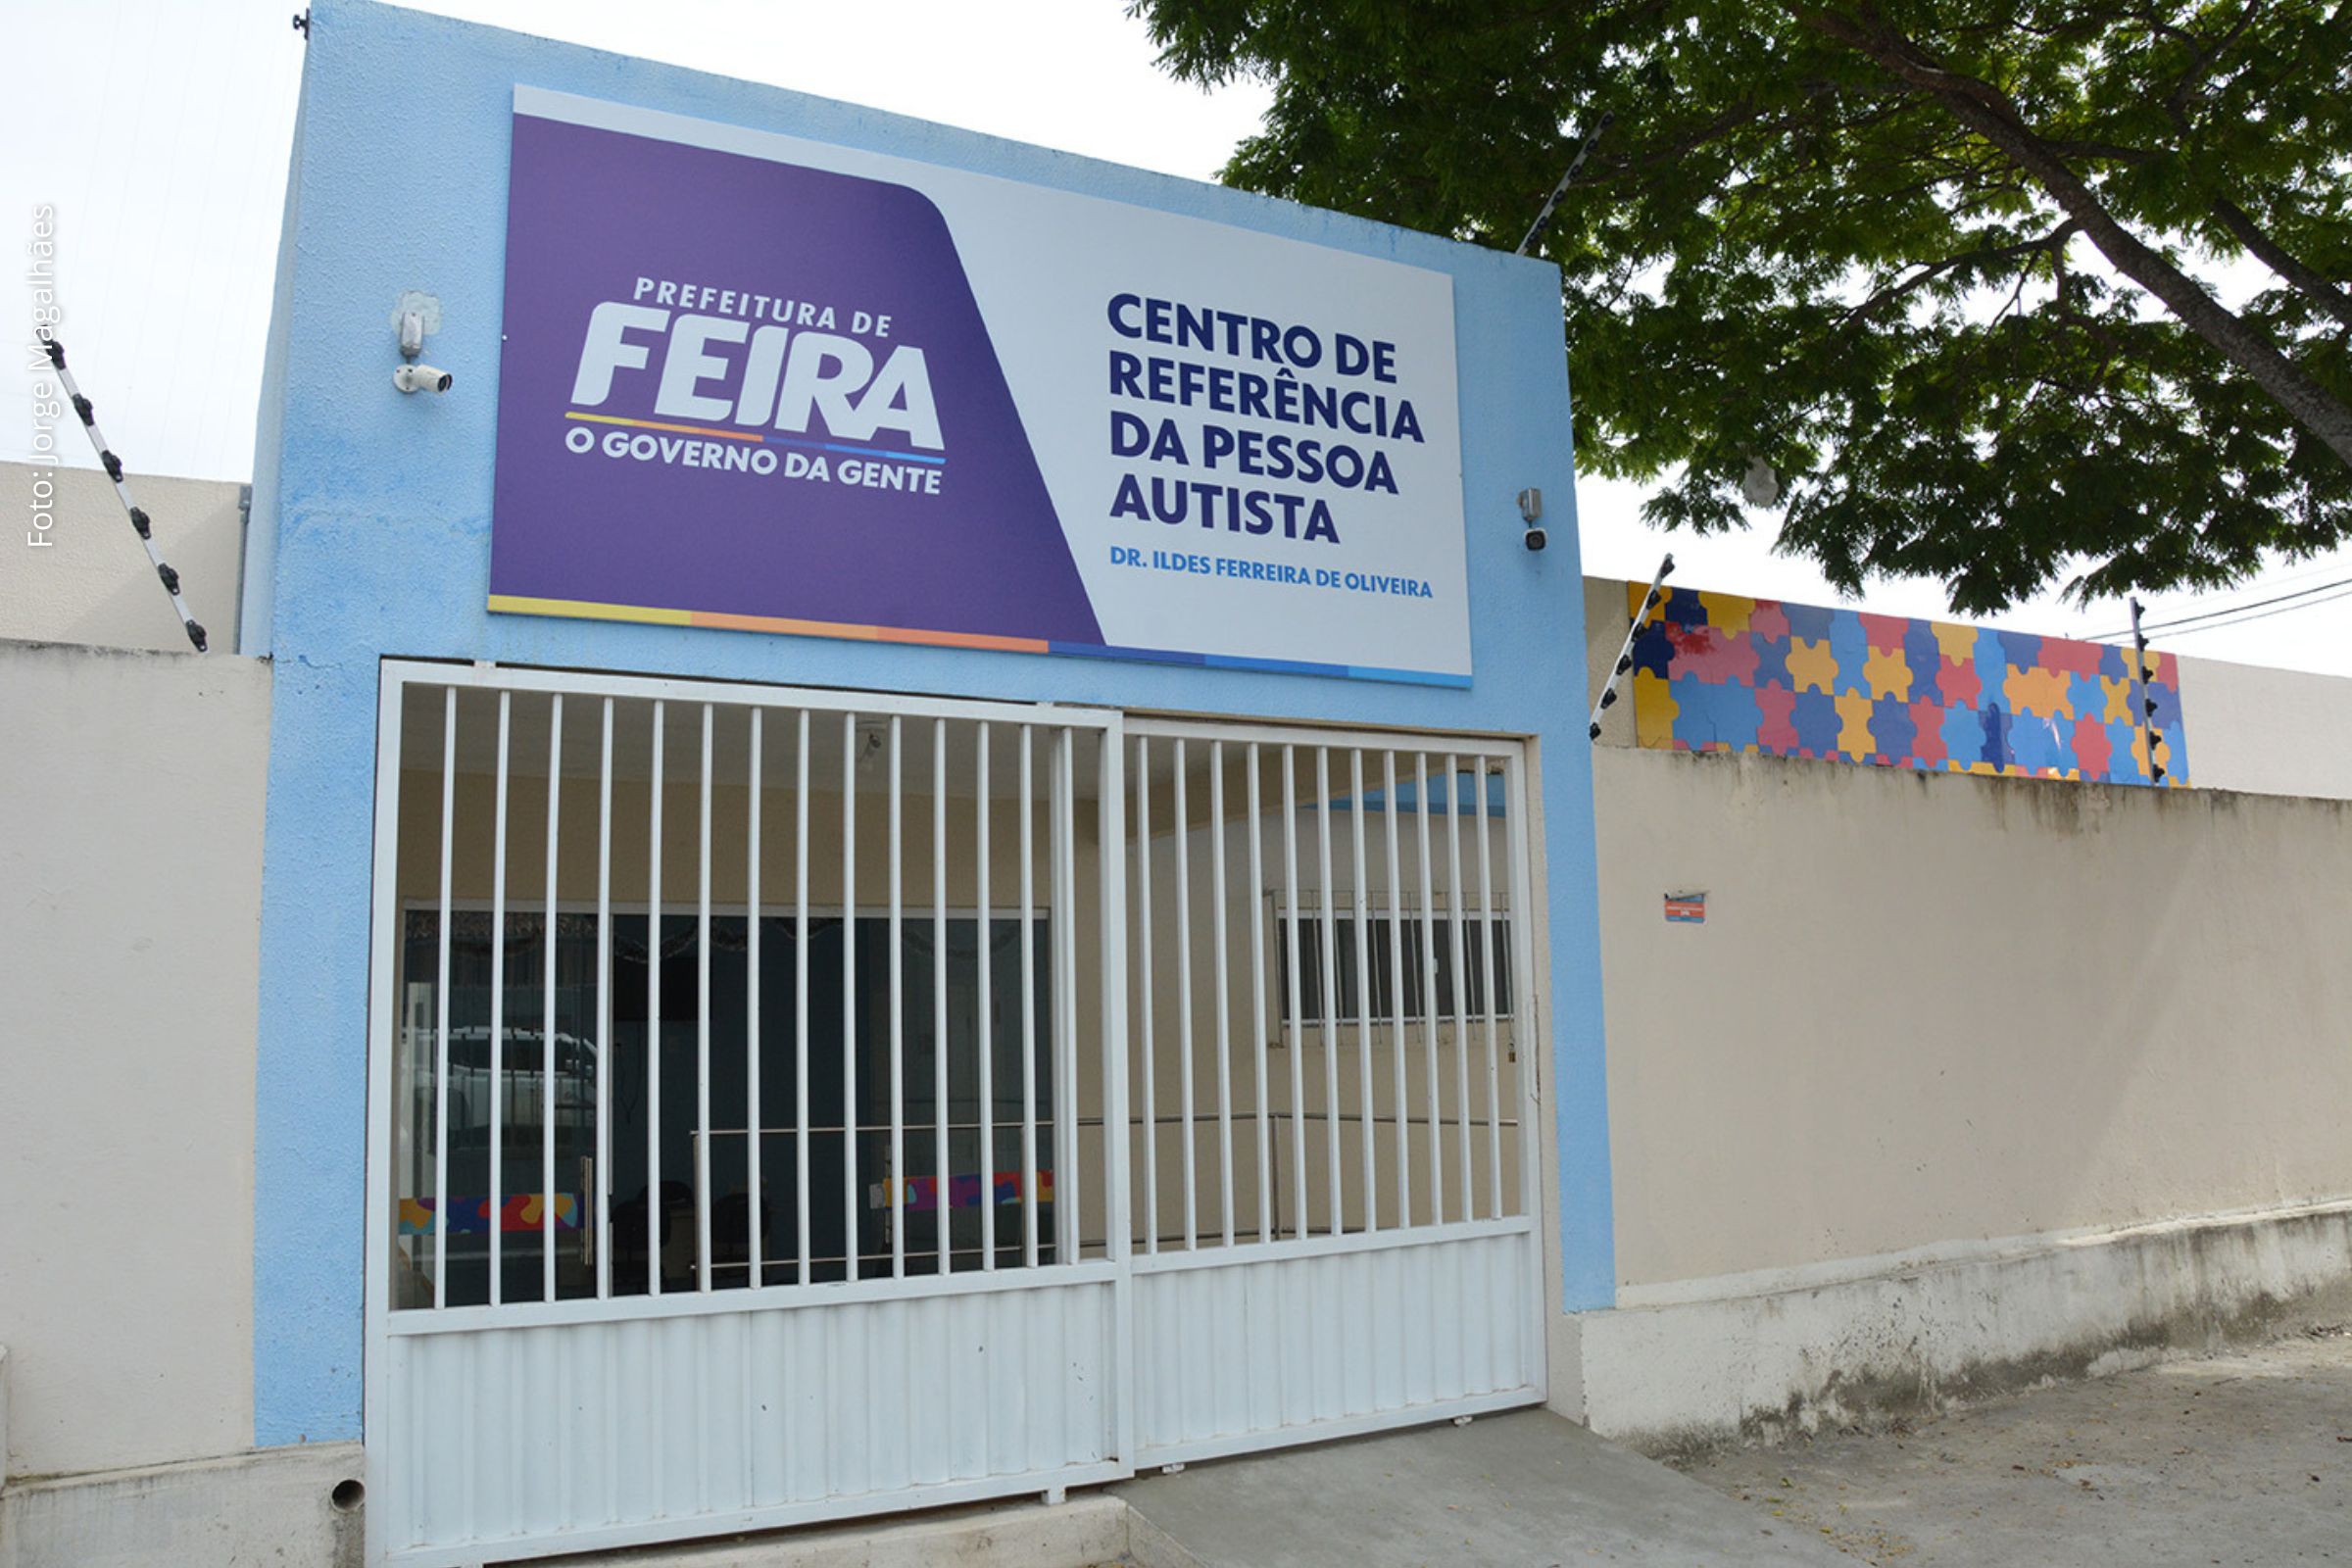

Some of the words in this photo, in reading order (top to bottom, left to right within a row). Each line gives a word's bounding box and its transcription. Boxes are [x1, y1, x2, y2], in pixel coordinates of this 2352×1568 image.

[633, 276, 836, 330] PREFEITURA
[851, 311, 892, 338] DE
[1106, 293, 1323, 369] CENTRO
[1335, 332, 1397, 384] DE
[570, 301, 945, 451] FEIRA
[1109, 350, 1425, 444] REFERÊNCIA
[564, 426, 595, 454] O
[602, 431, 778, 475] GOVERNO
[784, 452, 830, 482] DA
[837, 459, 943, 495] GENTE
[1110, 410, 1190, 466] DA
[1202, 424, 1399, 495] PESSOA
[1109, 473, 1341, 544] AUTISTA
[1109, 546, 1148, 568] DR.
[1152, 551, 1211, 575] ILDES
[1215, 558, 1311, 585] FERREIRA
[1315, 568, 1342, 588] DE
[1345, 572, 1434, 599] OLIVEIRA
